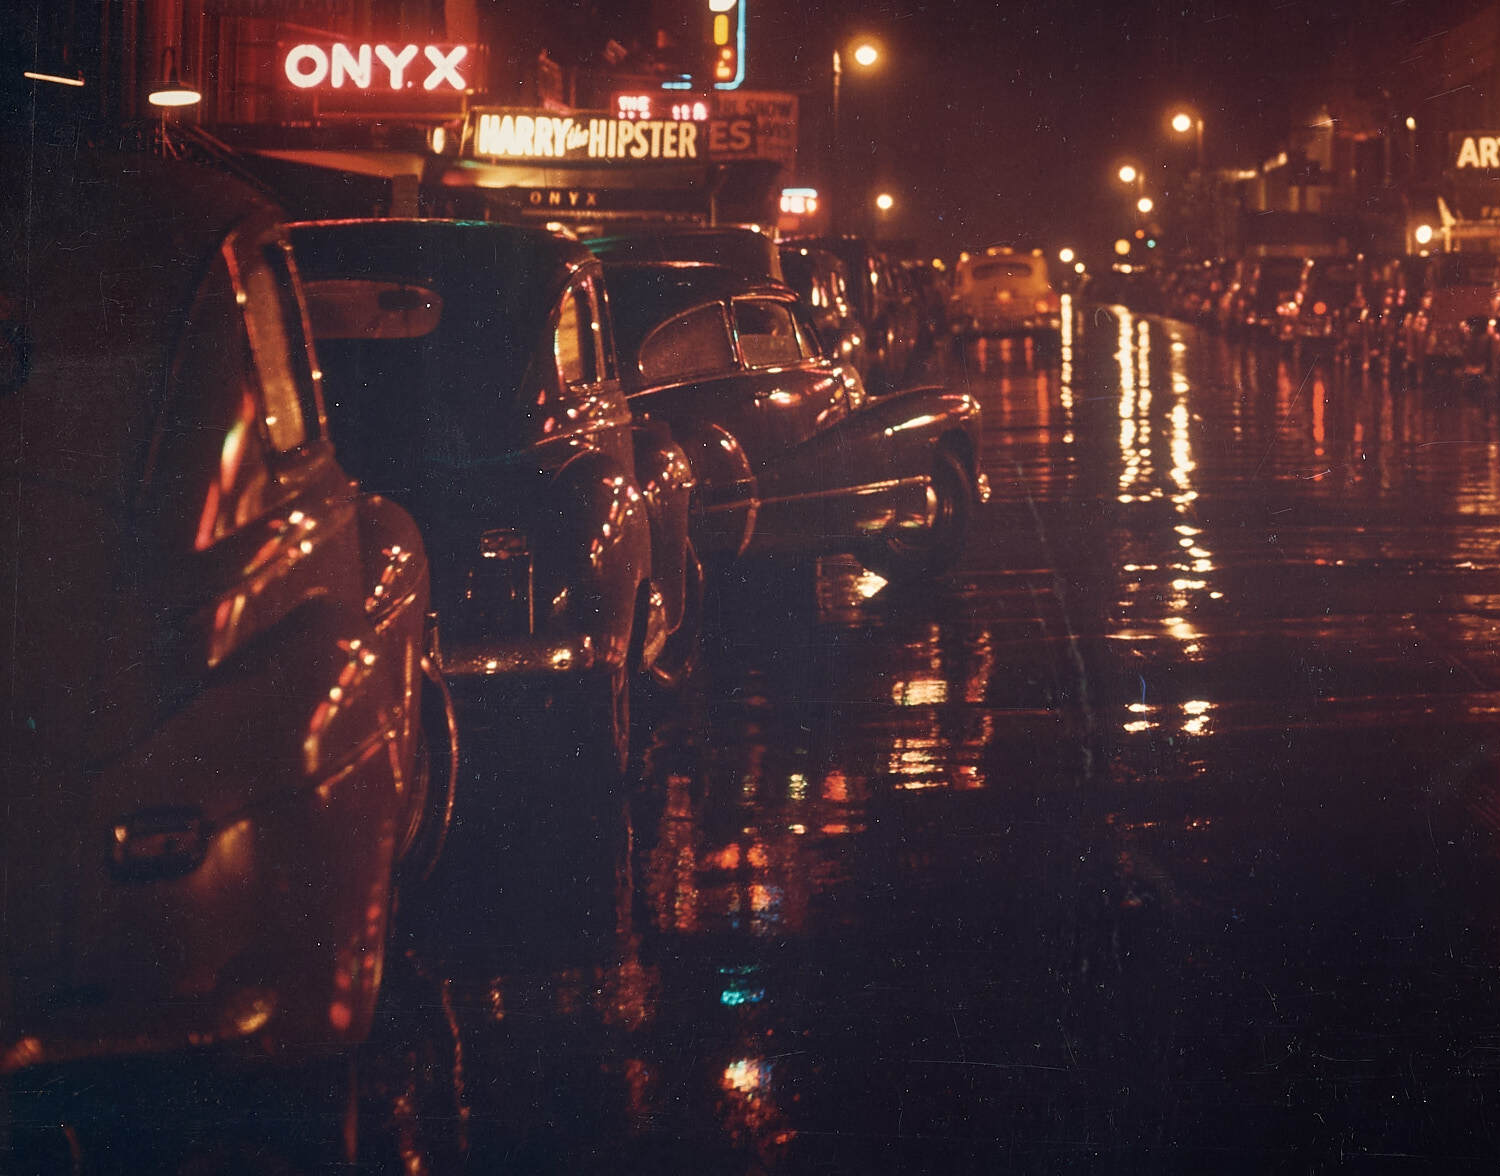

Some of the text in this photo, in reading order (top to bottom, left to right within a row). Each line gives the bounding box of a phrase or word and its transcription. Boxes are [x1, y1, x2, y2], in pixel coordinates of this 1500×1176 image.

[285, 43, 469, 91] ONYX
[479, 114, 574, 158] HARRY
[588, 119, 698, 159] HIPSTER
[530, 190, 597, 206] ONYX
